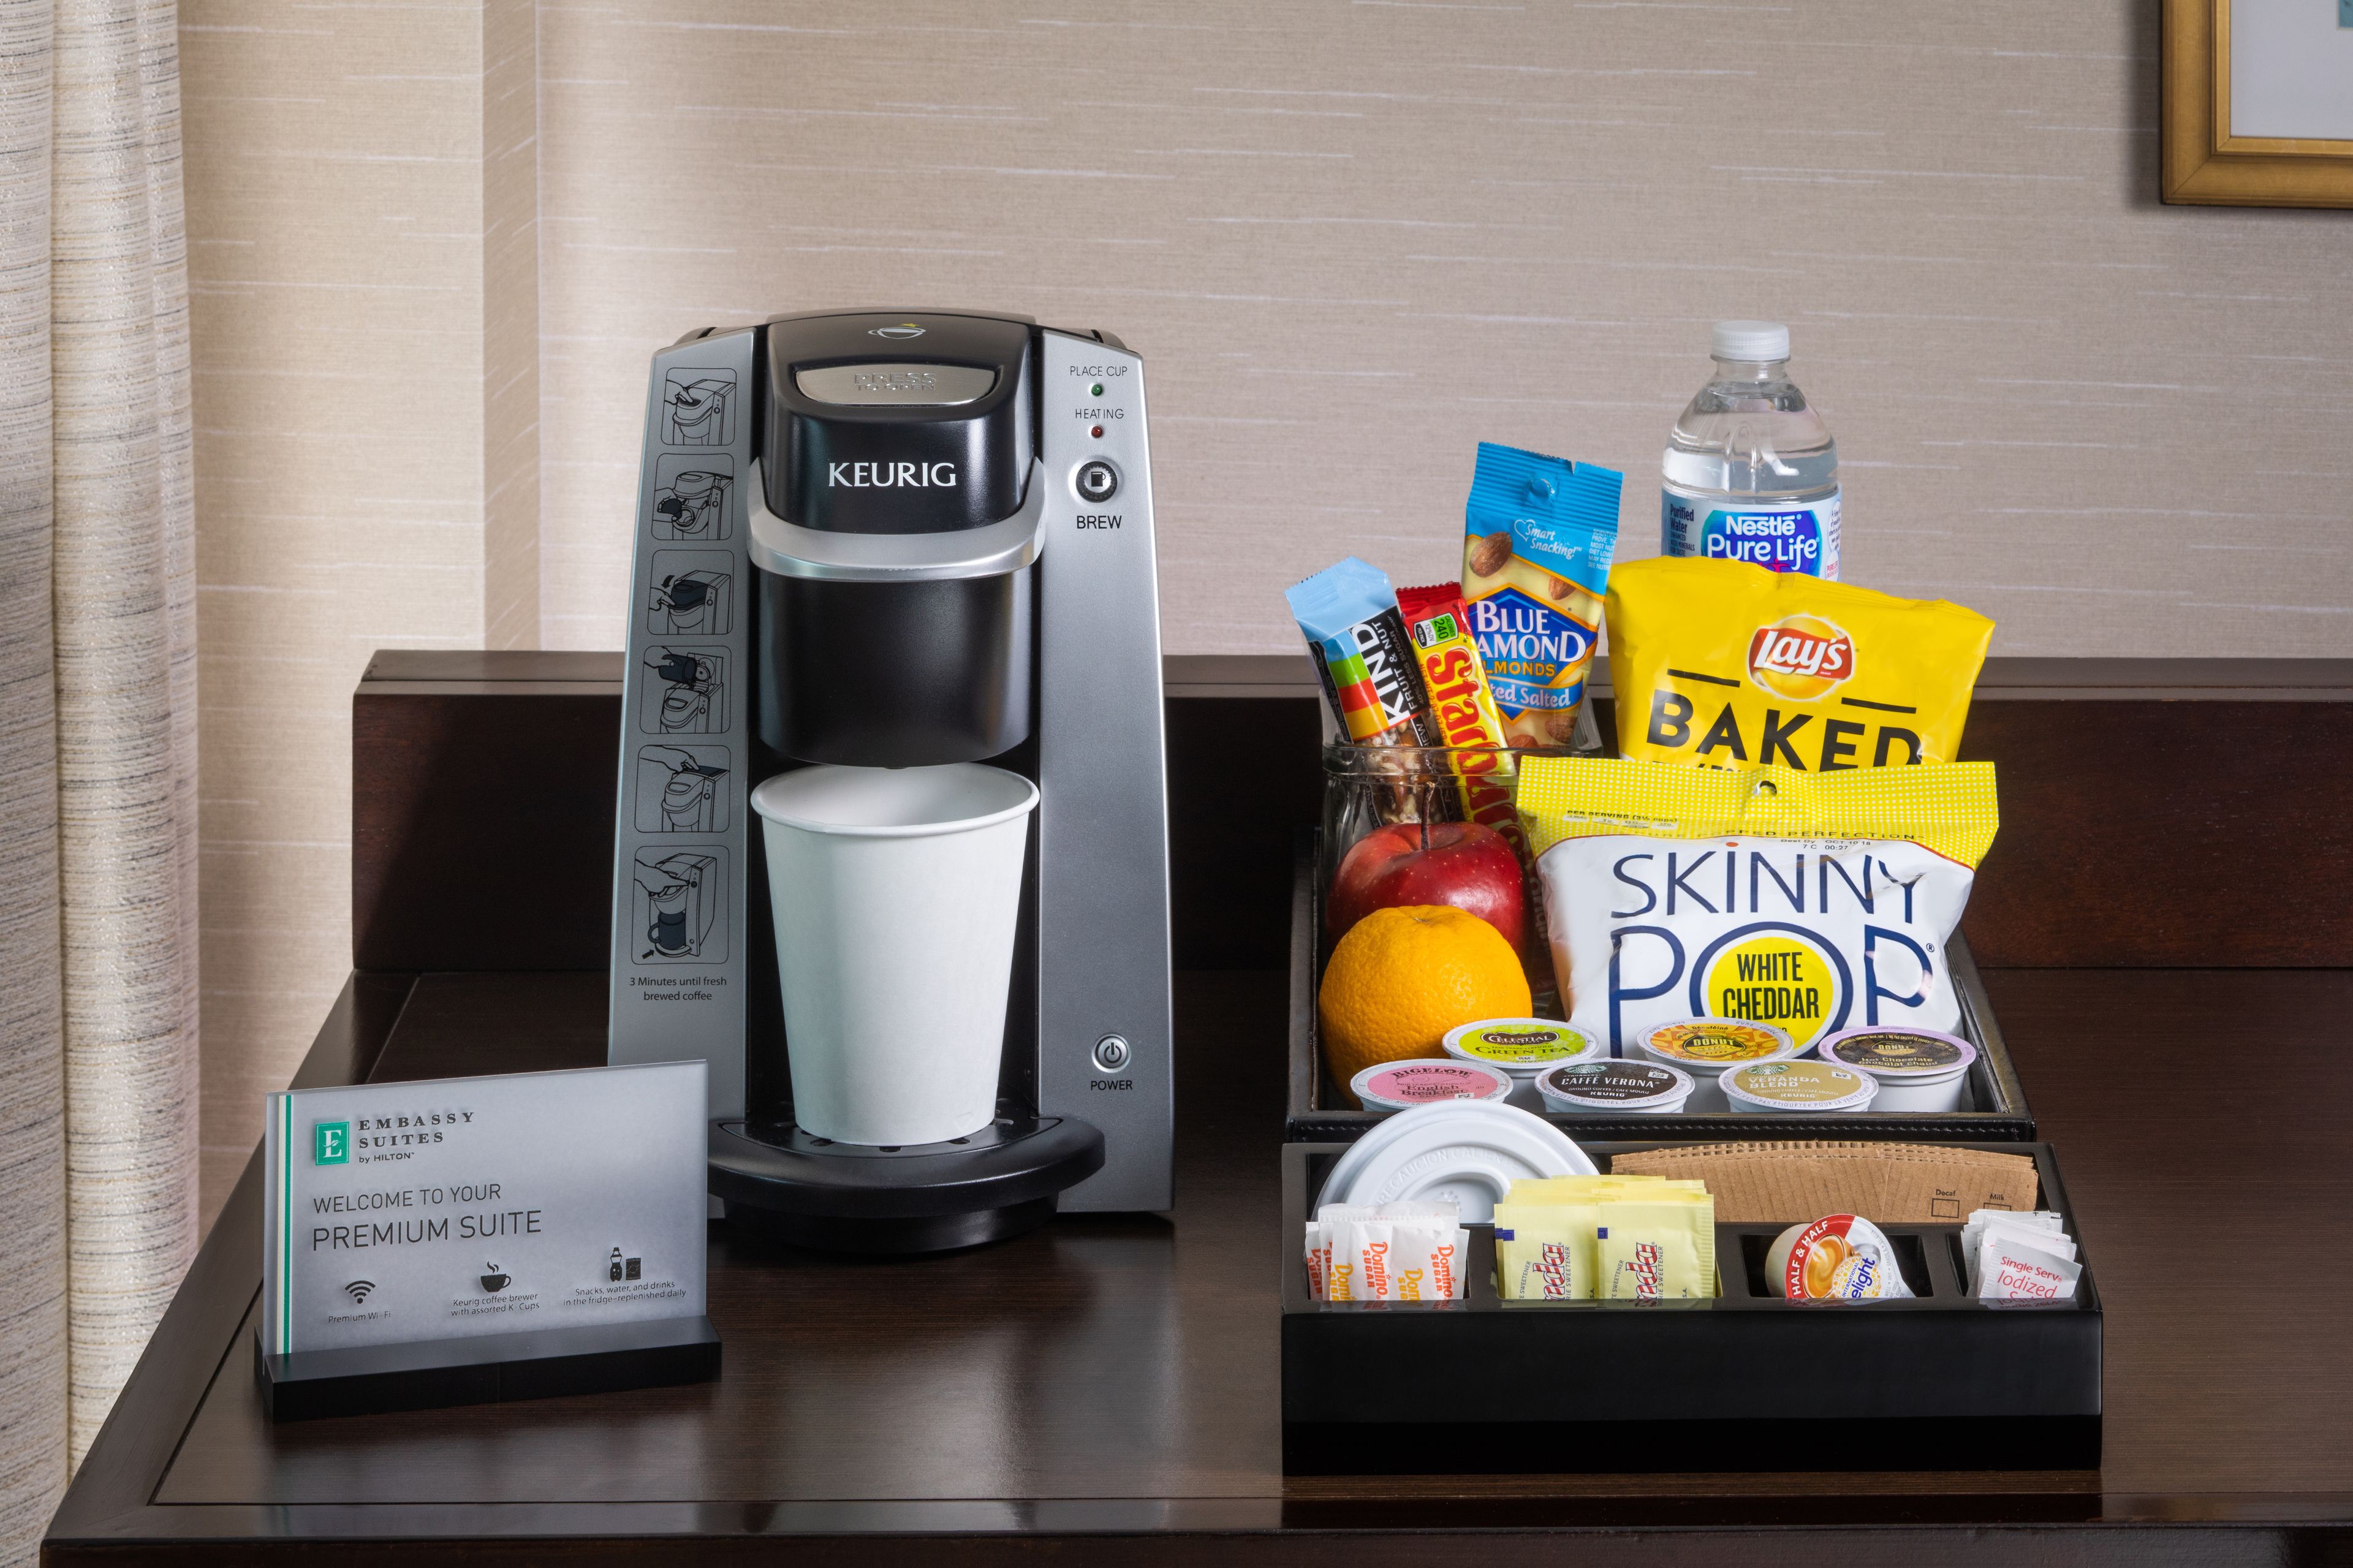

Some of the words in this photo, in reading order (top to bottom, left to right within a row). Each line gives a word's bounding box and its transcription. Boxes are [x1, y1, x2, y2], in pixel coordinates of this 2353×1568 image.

[855, 373, 936, 383] PRESS
[1070, 366, 1102, 376] PLACE
[1107, 366, 1127, 376] CUP
[1075, 408, 1124, 419] HEATING
[828, 463, 957, 487] KEURIG
[1077, 515, 1121, 529] BREW
[1670, 503, 1694, 521] Purified
[1525, 524, 1556, 540] Smart
[1670, 517, 1688, 534] Water
[1708, 534, 1771, 560] Pure
[1778, 534, 1818, 570] Life
[1435, 618, 1449, 639] 240
[1445, 615, 1456, 637] CALORIES
[1476, 600, 1550, 634] BLUE
[1372, 622, 1392, 650] NUT
[1390, 631, 1406, 662] SUGAR
[1477, 631, 1586, 663] AMOND
[1389, 653, 1398, 662] &
[1754, 631, 1847, 676] Lay's
[1351, 623, 1411, 726] KIND
[1404, 664, 1418, 687] LESS
[1417, 663, 1428, 679] NET
[1483, 660, 1556, 676] LMONDS
[1394, 668, 1418, 711] FRUIT
[1490, 683, 1517, 702] ted
[1520, 687, 1571, 706] Salted
[1646, 689, 1922, 773] BAKED
[1610, 842, 1927, 924] SKINNY
[1737, 952, 1803, 982] WHITE
[629, 977, 635, 986] 3
[638, 977, 676, 986] Minutes
[680, 977, 700, 986] until
[703, 976, 727, 986] fresh
[643, 991, 680, 1001] brewed
[683, 991, 712, 1001] coffee
[1723, 987, 1820, 1020] CHEDDAR
[1476, 1047, 1534, 1055] GREEN
[1488, 1035, 1552, 1044] CELESTIAL
[1694, 1037, 1735, 1046] DONUT
[1091, 1080, 1132, 1091] POWER
[1391, 1068, 1472, 1079] BIGELOW
[358, 1112, 474, 1131] EMBASSY
[324, 1130, 342, 1158] E
[359, 1132, 443, 1149] SUITES
[1377, 1149, 1449, 1205] RECAUCION
[314, 1191, 413, 1214] WELCOME
[420, 1189, 443, 1205] TO
[450, 1184, 501, 1202] YOUR
[314, 1218, 448, 1251] PREMIUM
[460, 1210, 541, 1238] SUITE
[1802, 1221, 1828, 1246] HALF
[1795, 1248, 1805, 1258] &
[2000, 1256, 2033, 1273] Single
[1307, 1257, 1322, 1294] SUGAR
[1362, 1249, 1376, 1288] SUGAR
[1369, 1241, 1389, 1296] Domino
[1430, 1254, 1442, 1292] SUGAR
[1437, 1244, 1455, 1298] Domino
[1520, 1260, 1531, 1294] SWEETENER
[1612, 1260, 1624, 1293] SWEETENER
[1791, 1259, 1801, 1295] HALF
[1842, 1260, 1859, 1298] INTERNATIONAL
[1852, 1257, 1875, 1298] elight
[575, 1287, 605, 1296] Snacks,
[667, 1289, 686, 1298] daily
[1334, 1263, 1356, 1300] Domi
[1404, 1268, 1423, 1300] Dom
[1998, 1270, 2058, 1299] Iodized
[451, 1308, 469, 1316] with
[471, 1304, 506, 1314] assorted
[453, 1298, 479, 1308] Keurig
[482, 1295, 507, 1305] coffee
[509, 1293, 538, 1302] brewer
[328, 1312, 366, 1323] Premium
